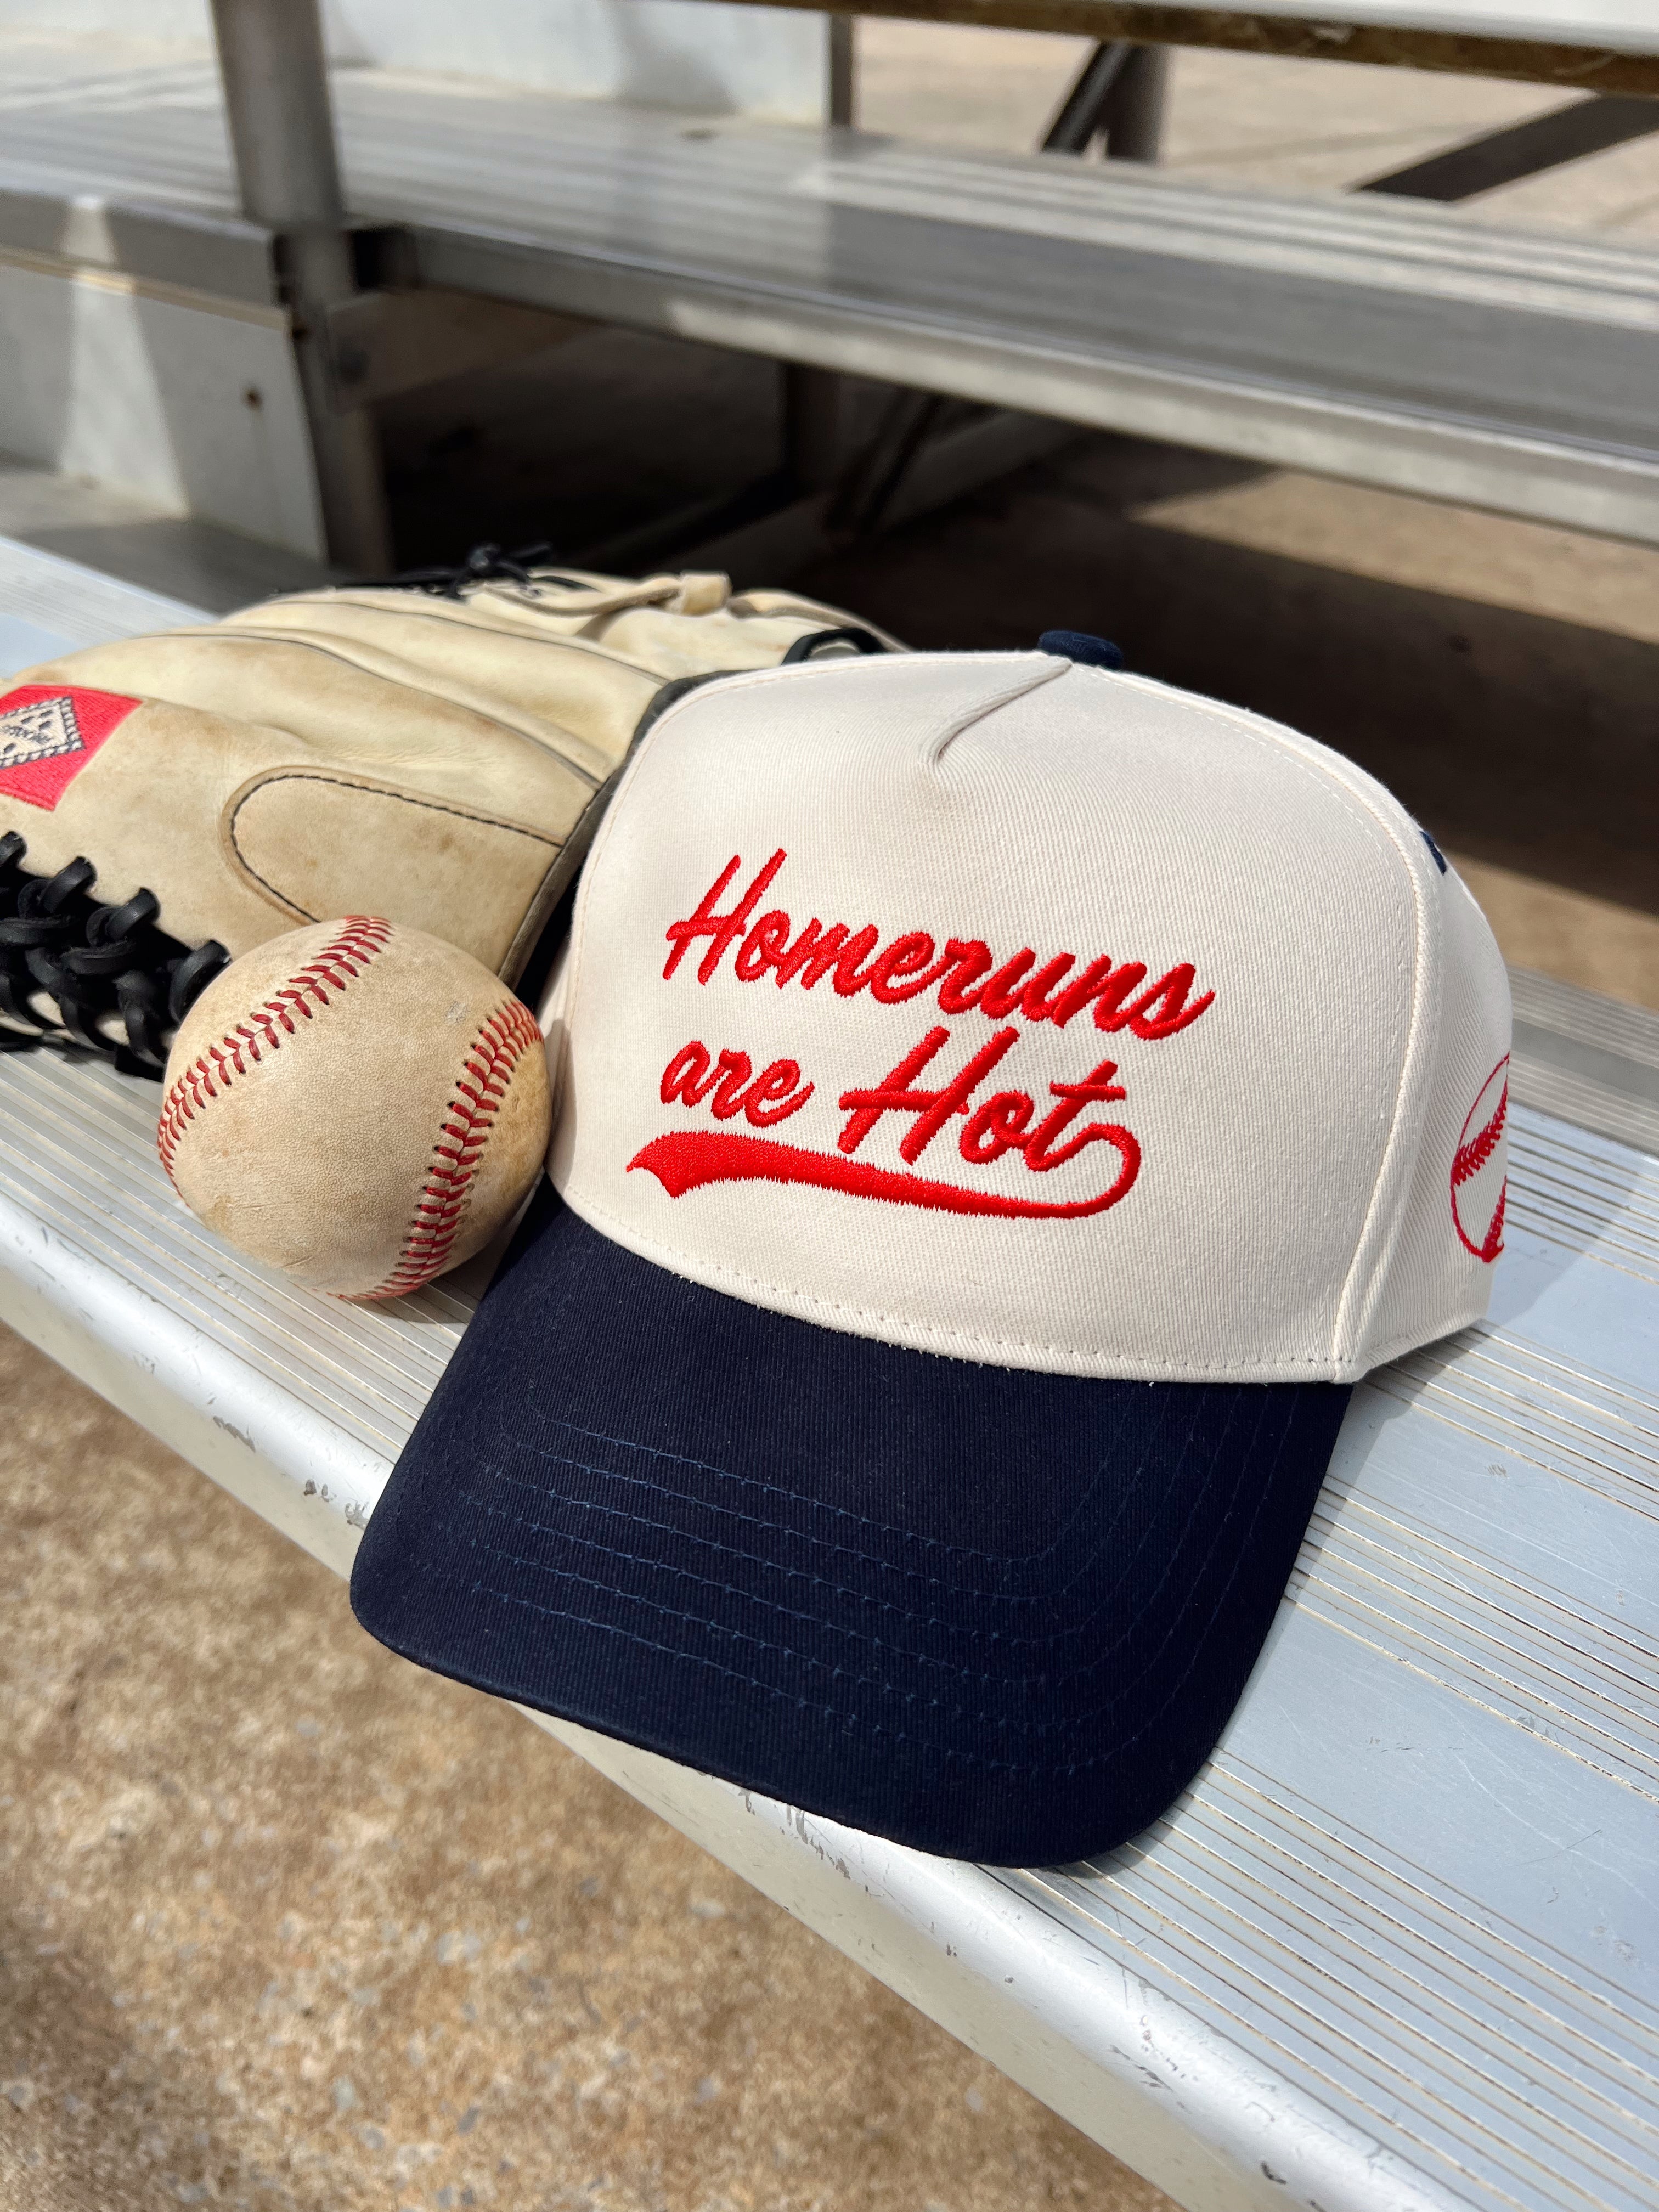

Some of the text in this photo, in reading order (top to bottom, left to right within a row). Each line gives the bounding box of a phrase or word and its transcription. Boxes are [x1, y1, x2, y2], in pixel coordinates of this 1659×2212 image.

[662, 848, 1216, 1041] Homeruns
[660, 1025, 1130, 1172] are Hot
